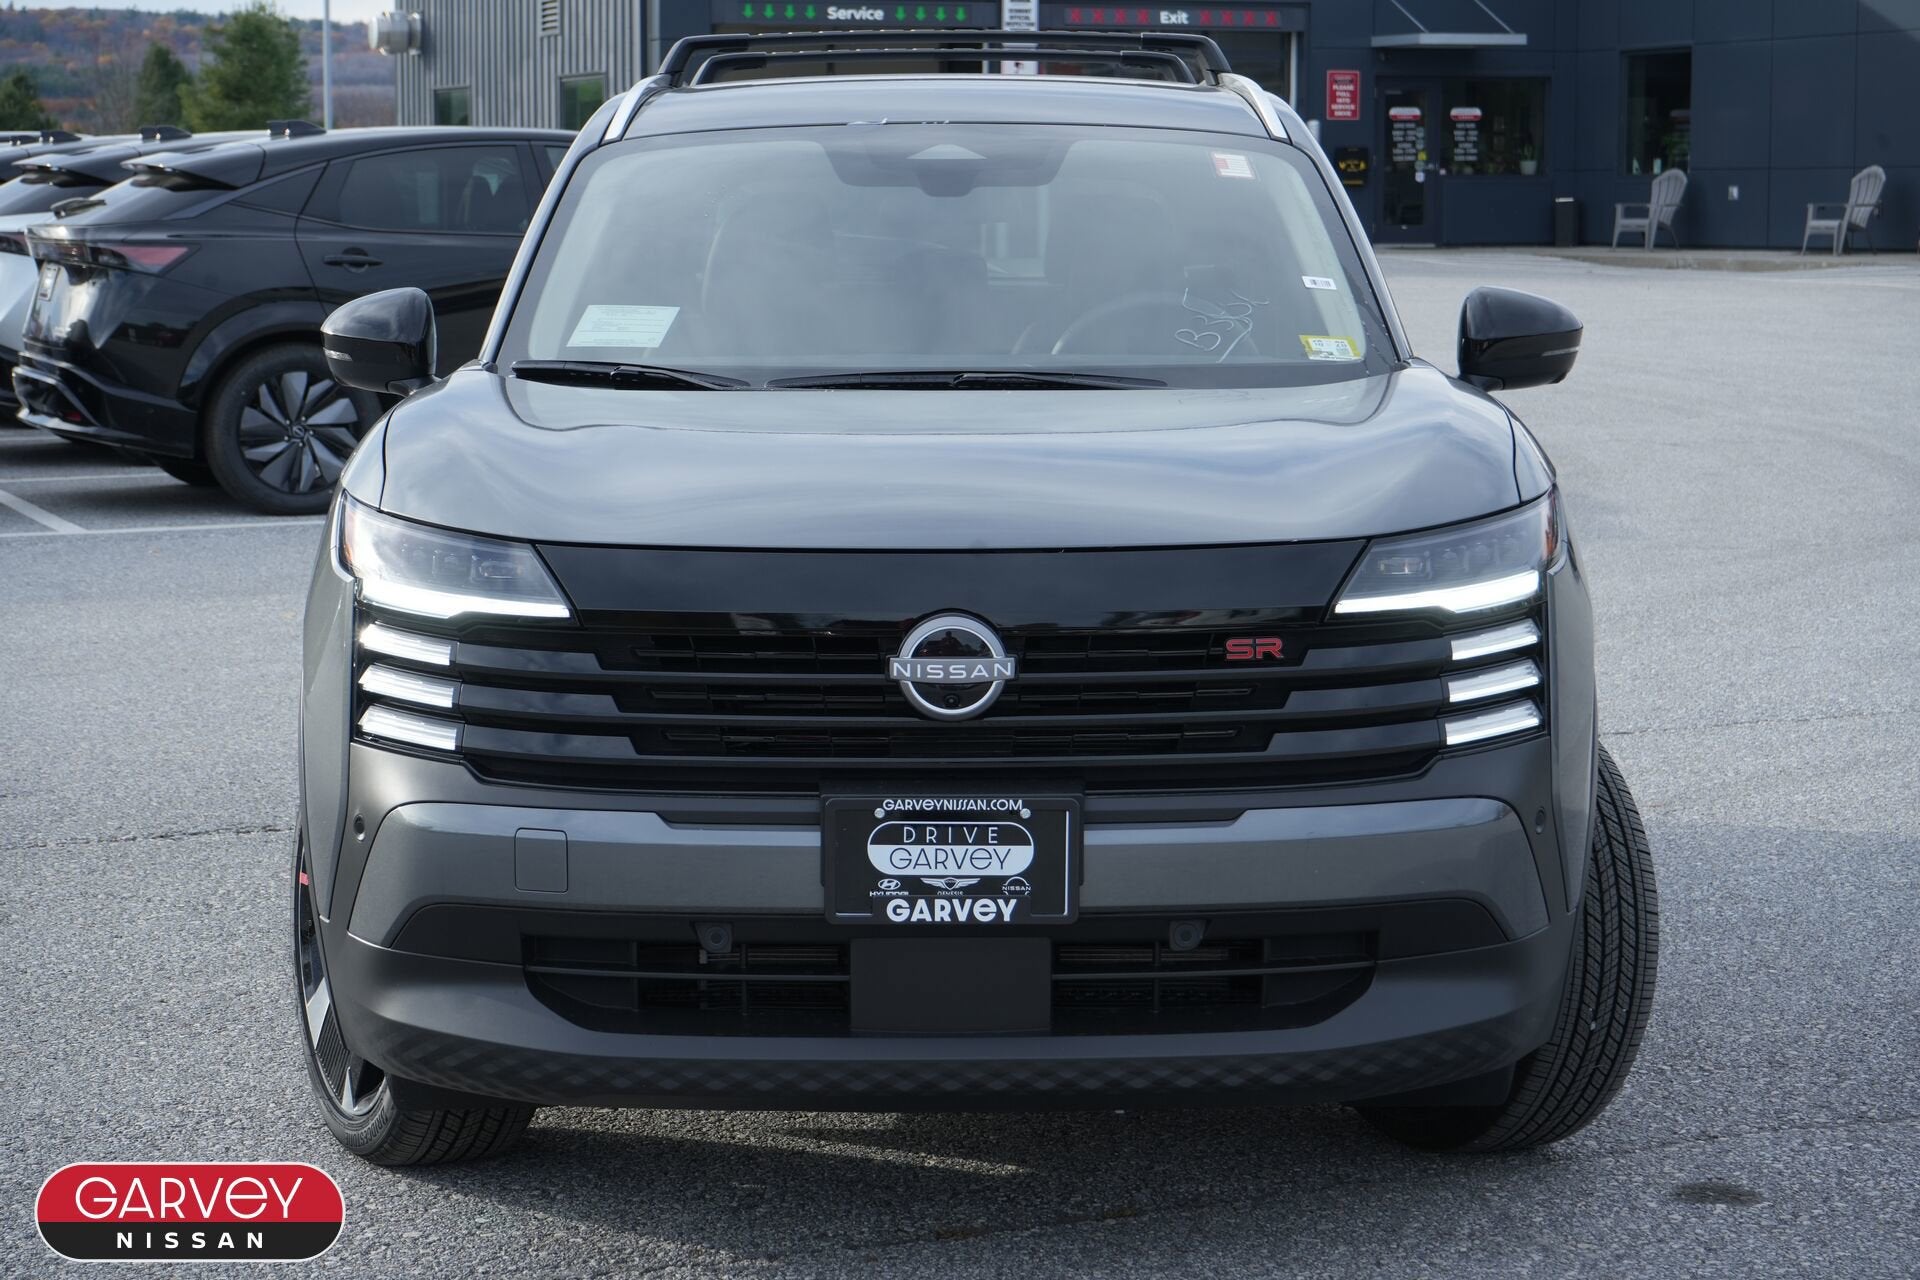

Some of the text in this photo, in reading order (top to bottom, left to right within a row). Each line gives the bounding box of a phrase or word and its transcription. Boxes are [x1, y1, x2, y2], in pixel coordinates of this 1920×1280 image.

[826, 5, 885, 21] Service
[1159, 10, 1190, 25] Exit
[1226, 638, 1282, 659] SR
[893, 662, 1013, 680] NISSAN
[882, 799, 1023, 812] GARVEYNISSAN.COM
[903, 826, 999, 844] DRIVE
[889, 847, 1012, 870] GARVEY
[886, 898, 1017, 923] GARVEY
